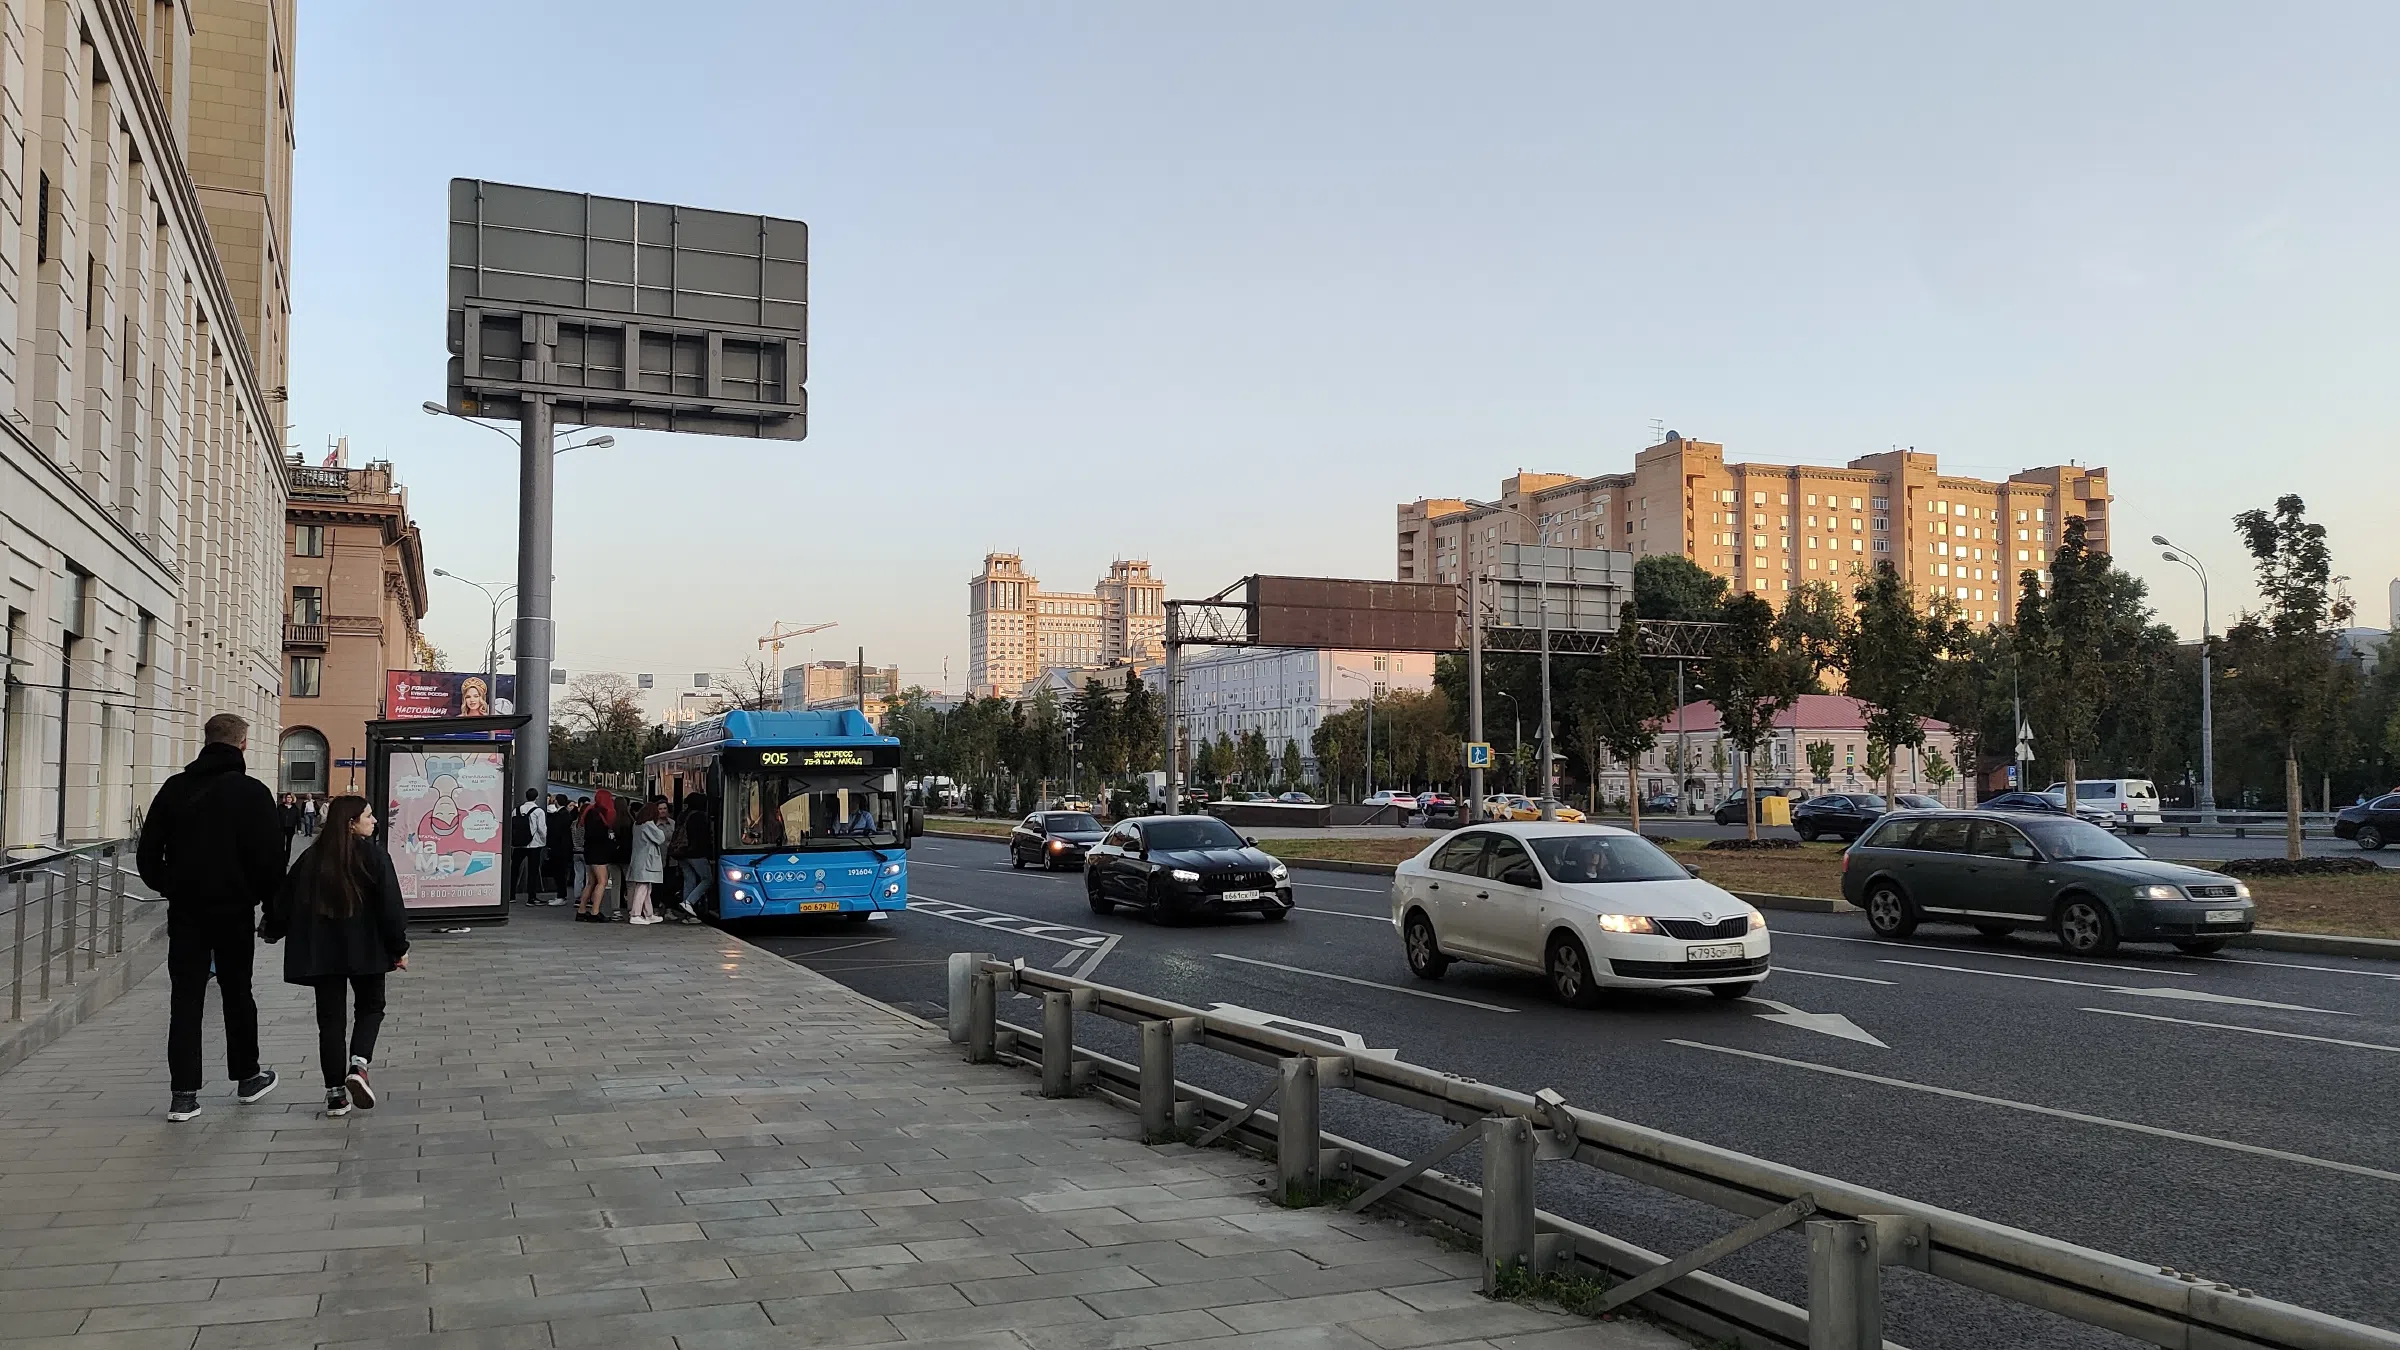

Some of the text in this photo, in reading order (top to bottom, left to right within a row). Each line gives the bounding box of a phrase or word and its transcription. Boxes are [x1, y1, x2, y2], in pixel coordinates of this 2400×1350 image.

[395, 705, 448, 715] НАСТОЯЩИЙ
[762, 752, 789, 765] 905
[813, 750, 853, 758] ЭКСПРЕСС
[837, 757, 863, 765] МКАД
